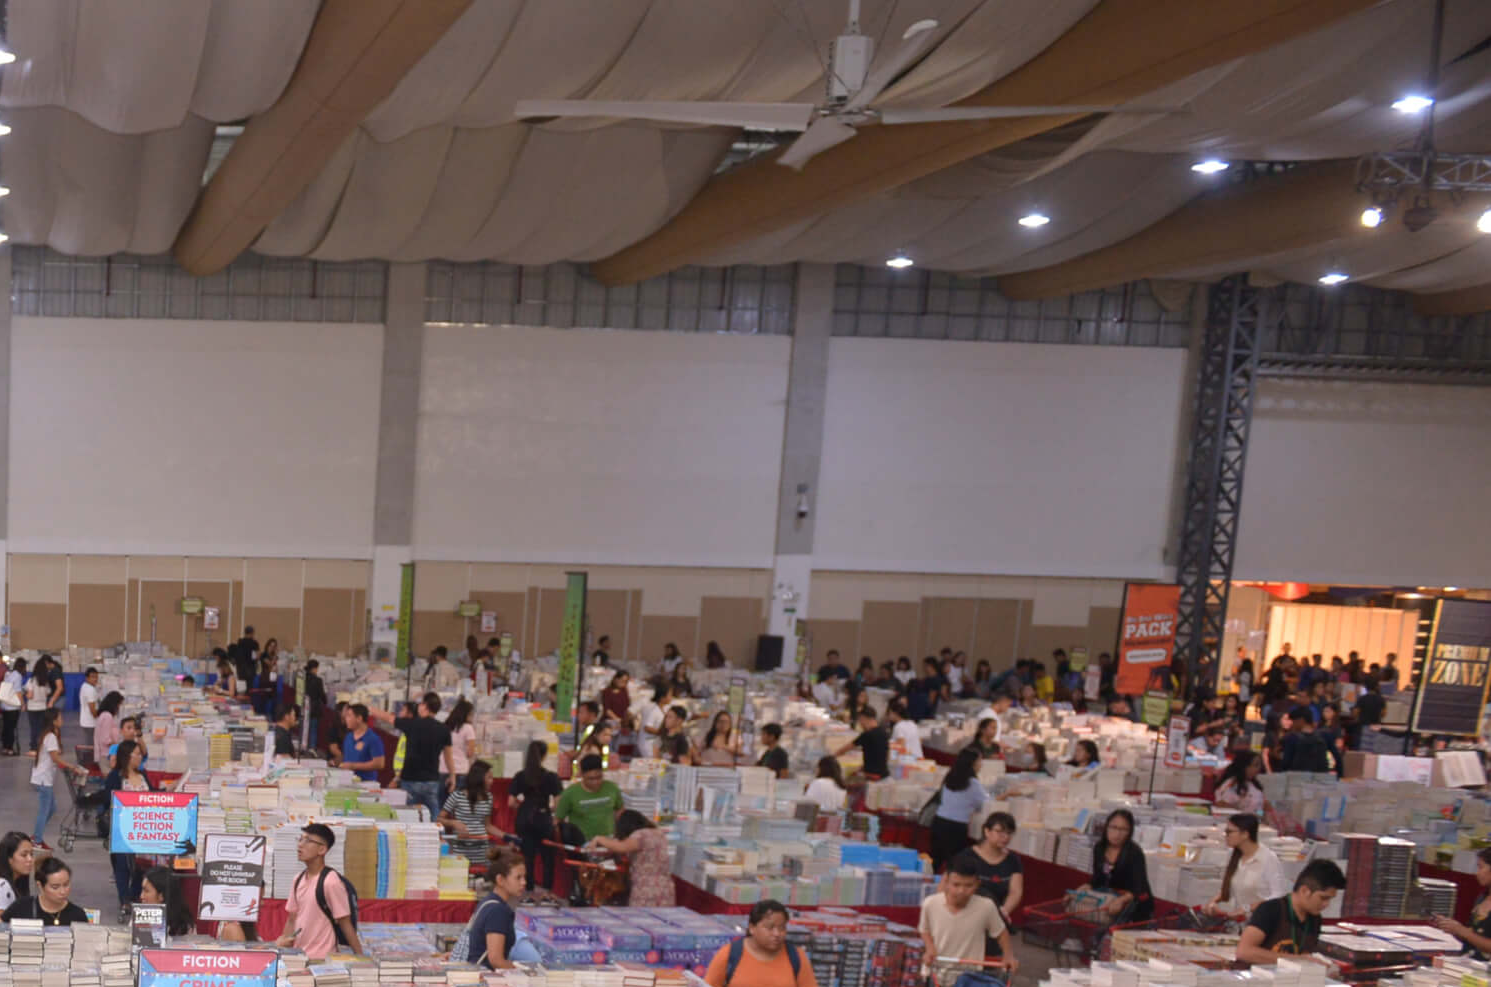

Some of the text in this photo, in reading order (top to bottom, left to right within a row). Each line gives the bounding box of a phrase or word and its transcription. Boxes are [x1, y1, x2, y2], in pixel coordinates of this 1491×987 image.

[1125, 621, 1173, 638] PACK
[1431, 660, 1487, 686] ZONE
[139, 794, 174, 803] FICTION
[133, 812, 175, 820] SCIENCE
[133, 822, 173, 831] FICTION
[128, 832, 181, 841] & FANTASY
[182, 955, 240, 968] FICTION
